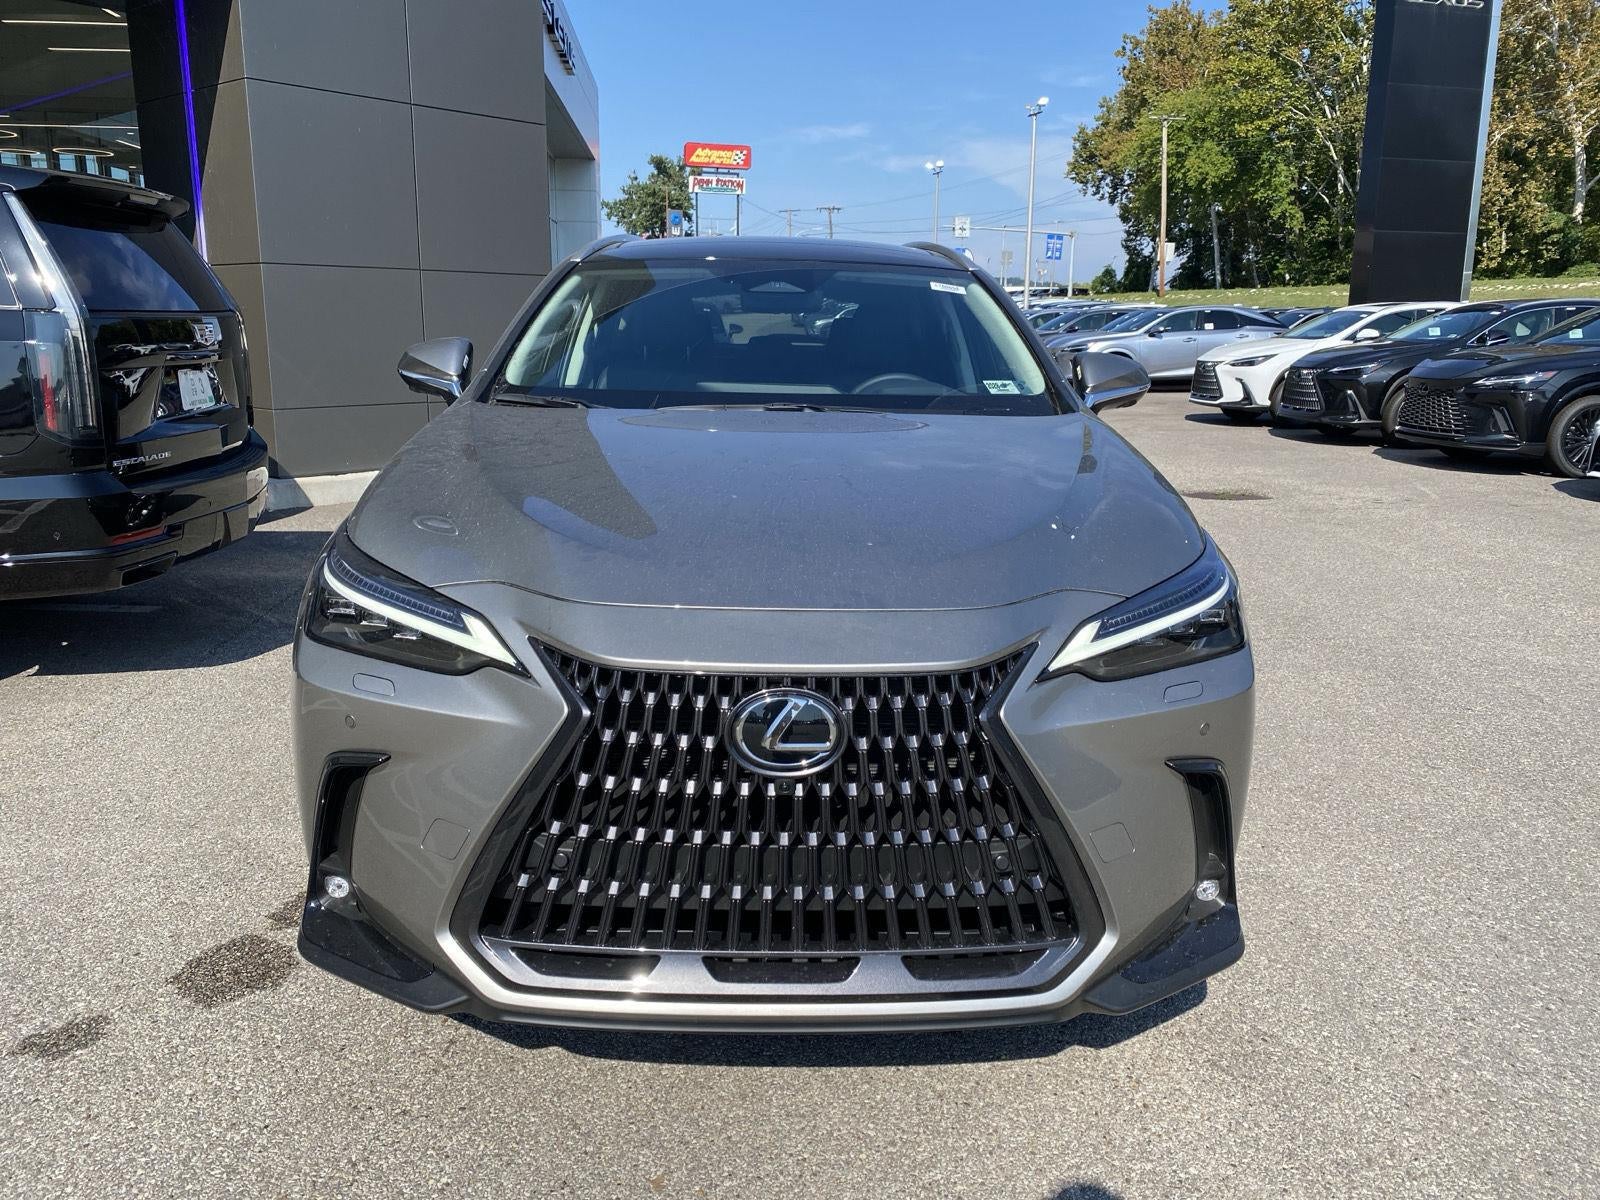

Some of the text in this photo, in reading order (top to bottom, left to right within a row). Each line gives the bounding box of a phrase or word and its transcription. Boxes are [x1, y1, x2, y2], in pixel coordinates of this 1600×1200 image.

[695, 147, 732, 158] Advance
[689, 155, 710, 163] Auto
[112, 451, 172, 466] ESCALADE
